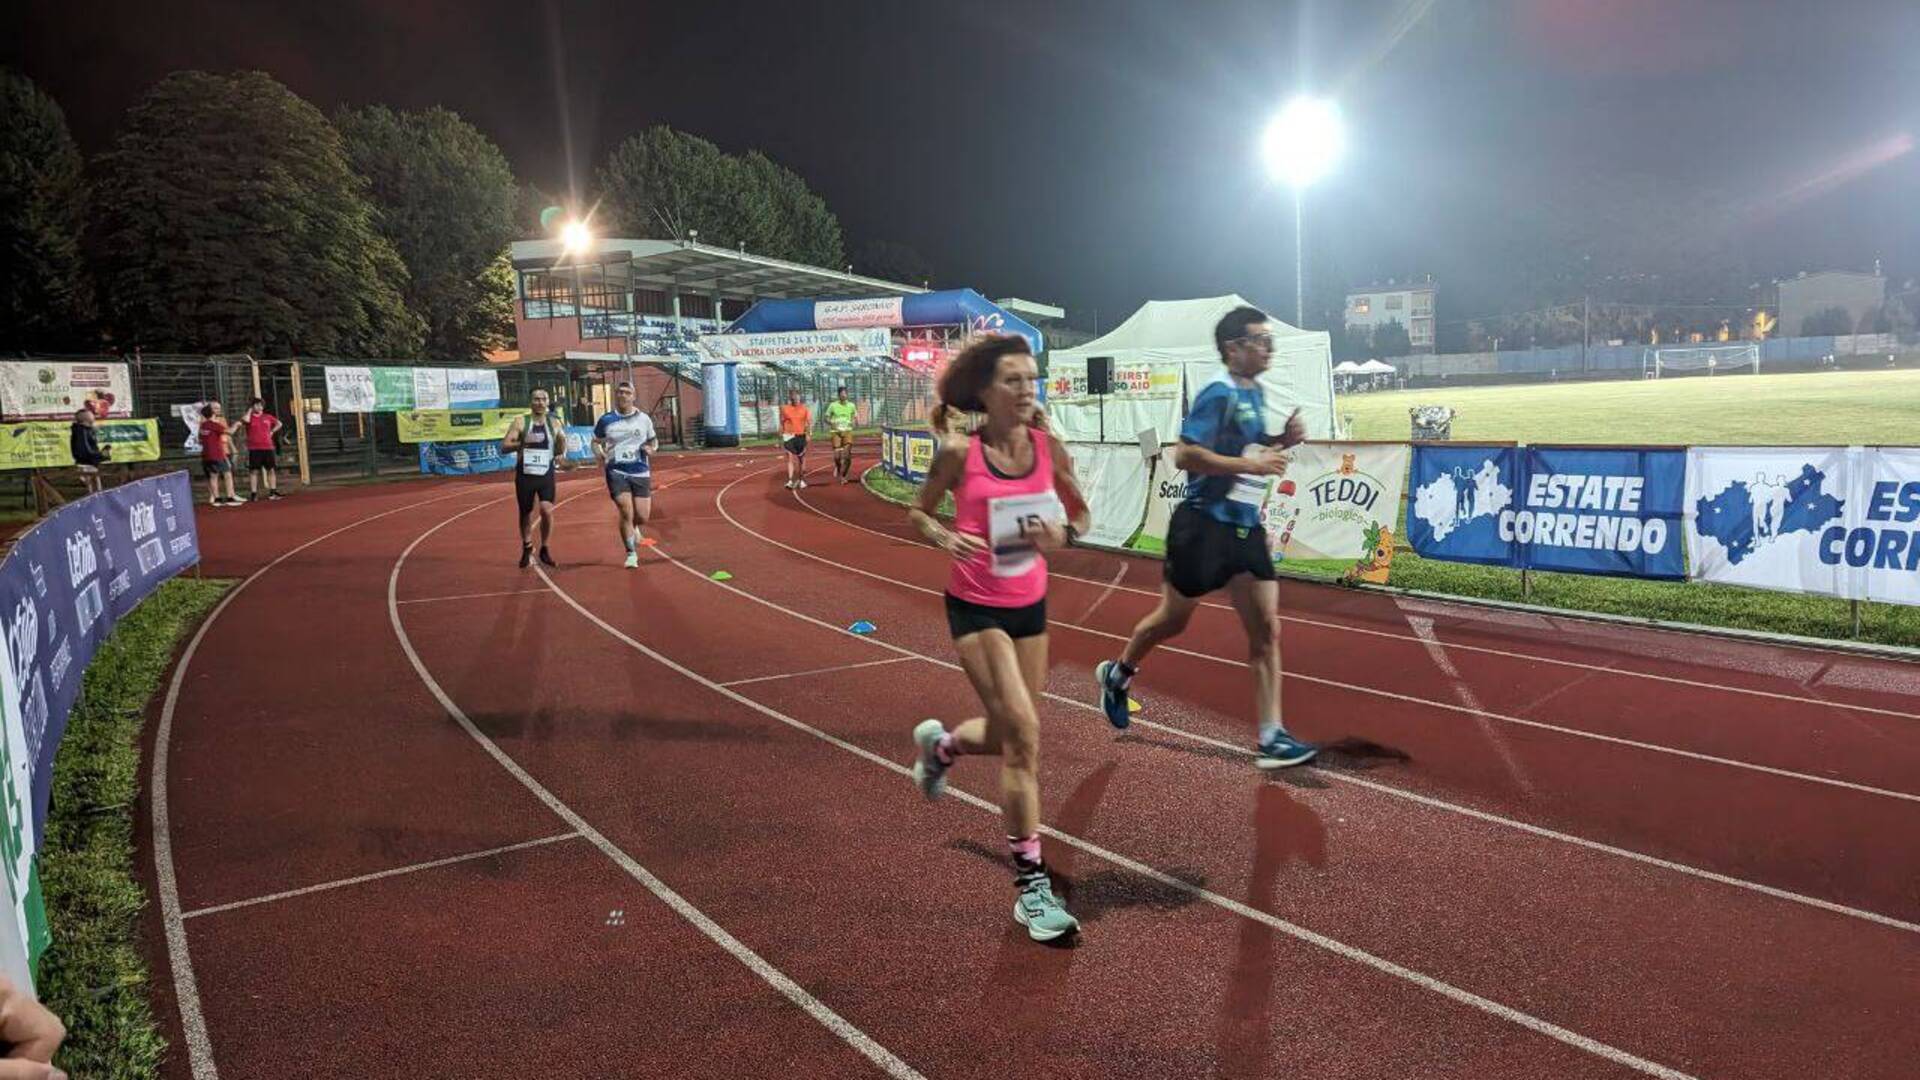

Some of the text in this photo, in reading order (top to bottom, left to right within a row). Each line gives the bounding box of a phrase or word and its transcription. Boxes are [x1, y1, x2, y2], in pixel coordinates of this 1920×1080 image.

[1116, 371, 1150, 380] FIRST
[1130, 381, 1150, 390] AID
[1309, 479, 1379, 511] TEDDI
[1527, 474, 1645, 512] ESTATE
[1499, 509, 1668, 555] CORRENDO
